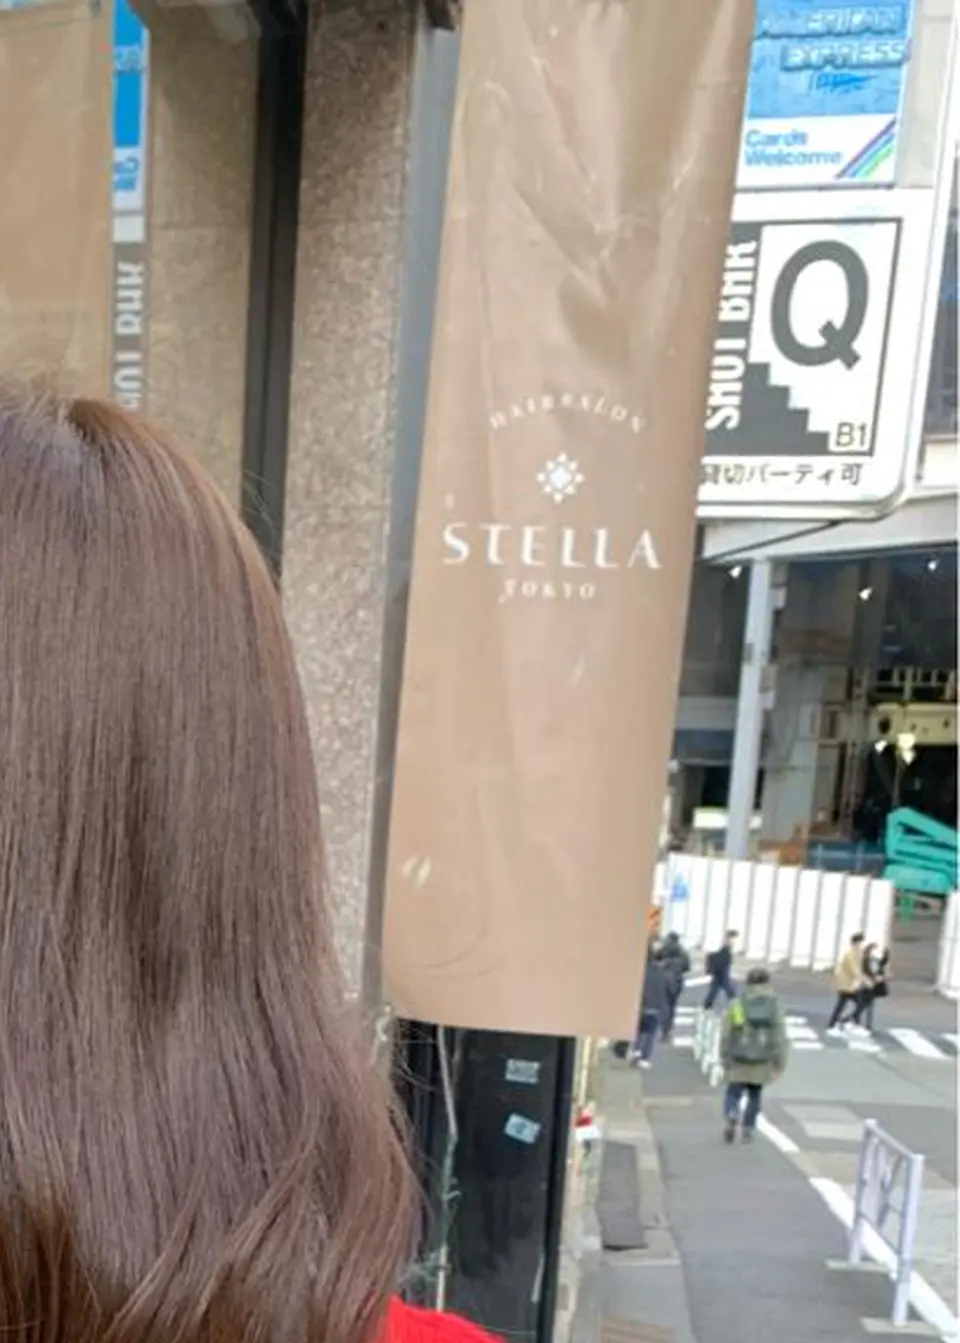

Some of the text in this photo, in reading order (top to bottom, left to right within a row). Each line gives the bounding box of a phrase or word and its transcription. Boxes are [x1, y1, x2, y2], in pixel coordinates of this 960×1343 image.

[781, 39, 907, 70] EXPRESS
[745, 127, 809, 148] Cards
[744, 150, 843, 167] Welcome
[770, 239, 870, 371] Q
[834, 422, 868, 447] B1
[702, 461, 864, 487] 貸切パーティ可
[442, 520, 663, 570] STELLA
[502, 578, 596, 601] TOKYO
